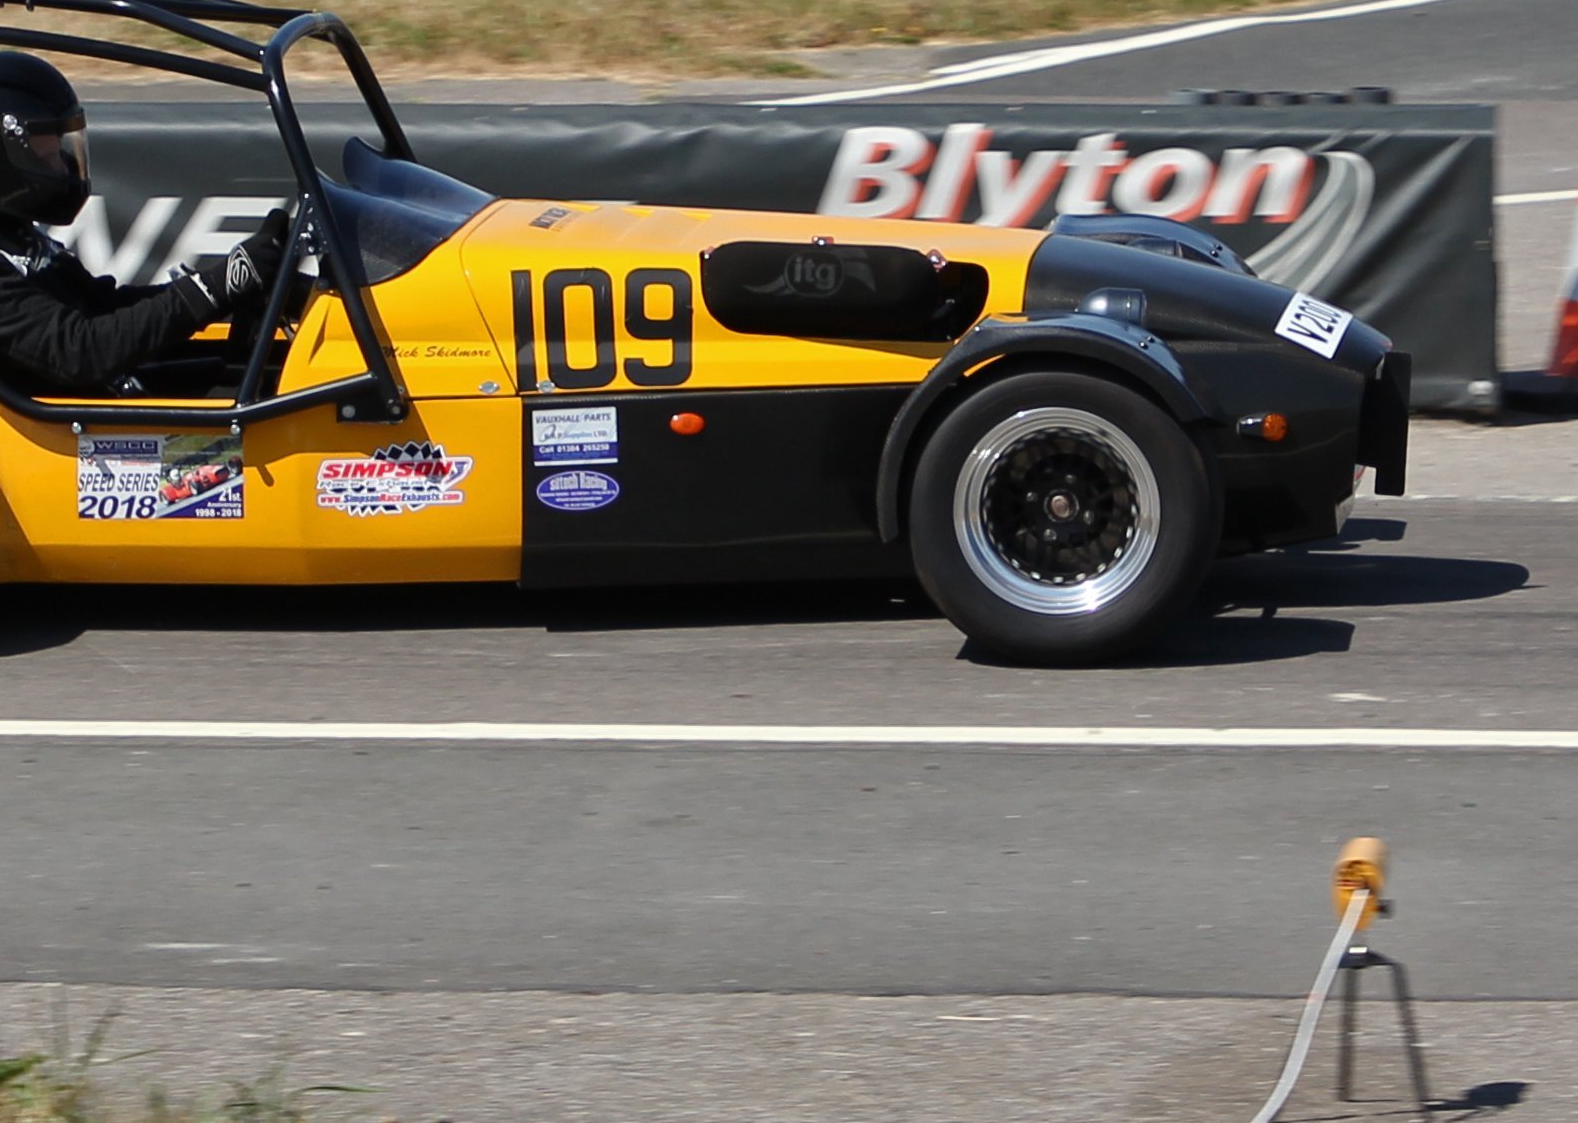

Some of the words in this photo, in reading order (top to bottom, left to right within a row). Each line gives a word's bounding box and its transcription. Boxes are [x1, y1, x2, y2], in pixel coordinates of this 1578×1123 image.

[816, 122, 1315, 227] Blyton
[511, 267, 693, 392] 109
[425, 345, 491, 357] Skidmore
[535, 415, 580, 424] VAUXHALL
[584, 412, 611, 422] PARTS
[322, 461, 453, 479] SIMPSON
[79, 472, 115, 493] SPEED
[117, 472, 160, 493] SERIES
[79, 495, 158, 519] 2018
